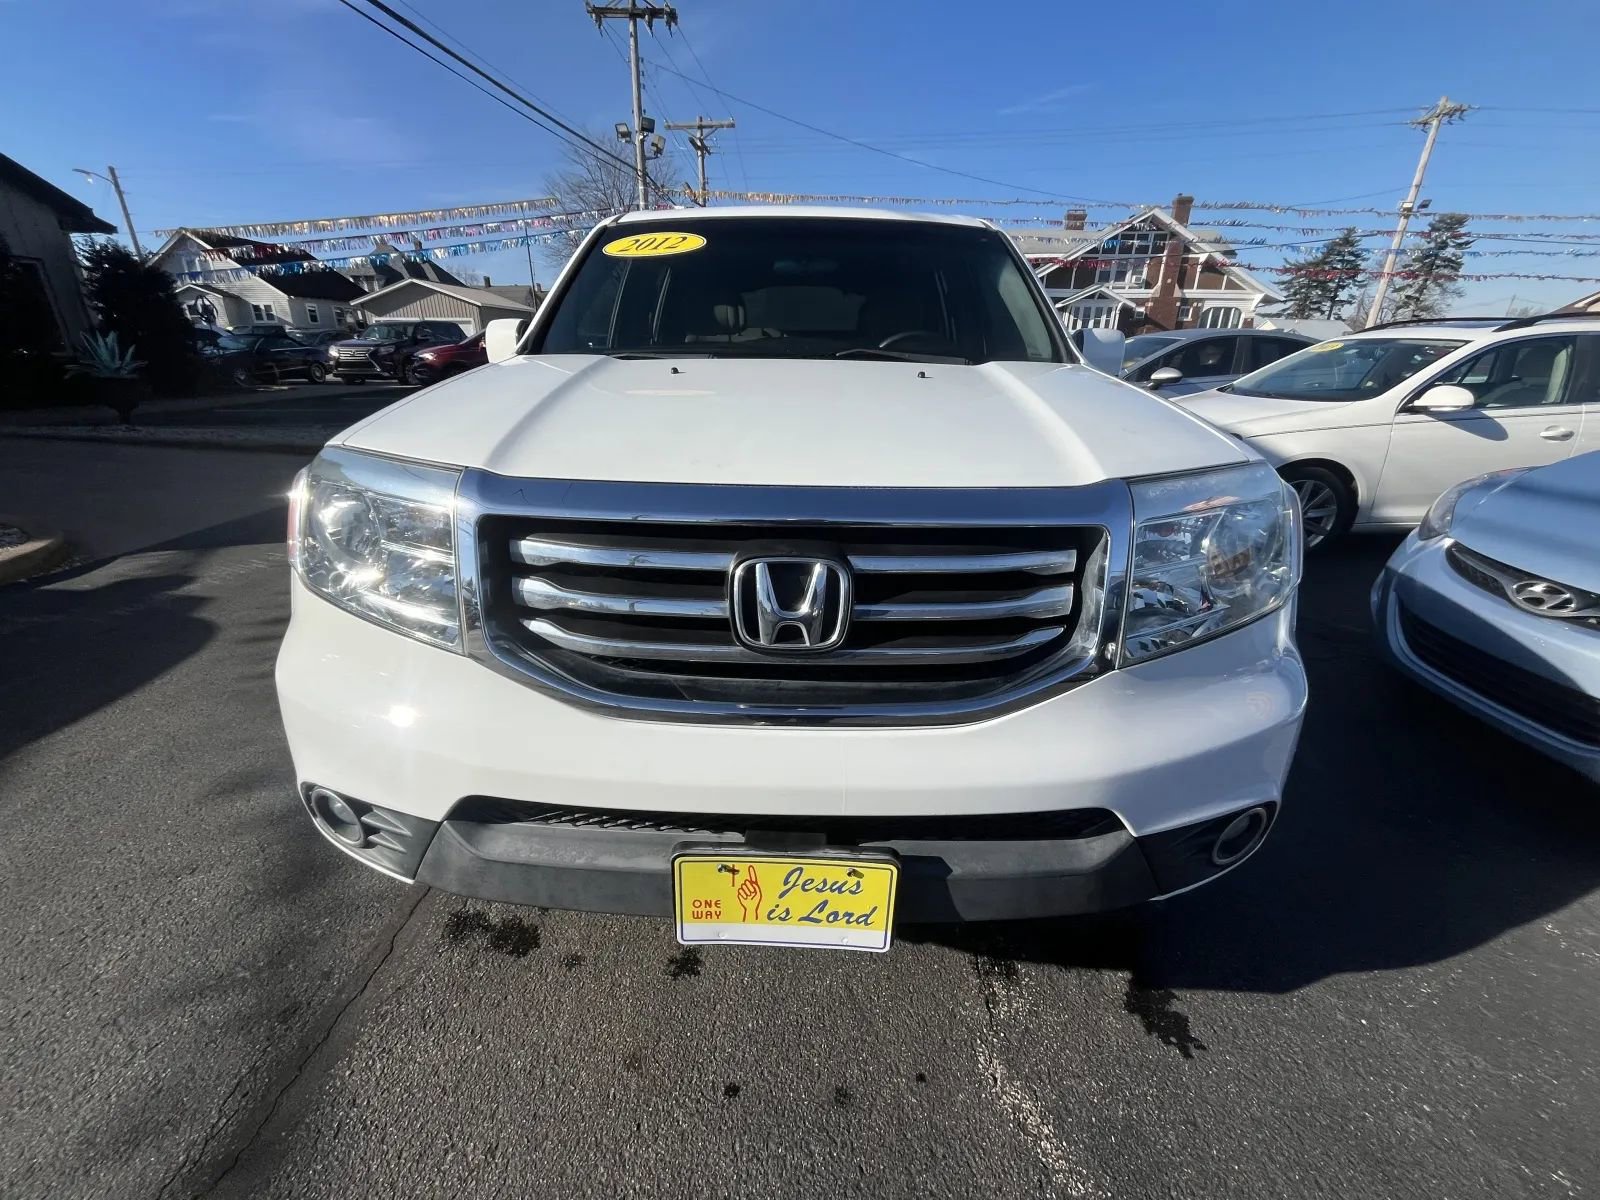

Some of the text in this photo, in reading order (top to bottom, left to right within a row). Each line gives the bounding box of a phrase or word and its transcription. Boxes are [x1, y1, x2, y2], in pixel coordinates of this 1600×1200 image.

[617, 236, 688, 253] 2012
[778, 866, 864, 899] Jesus
[692, 899, 722, 909] ONE
[692, 910, 722, 920] WAY
[766, 899, 878, 927] is Lord
